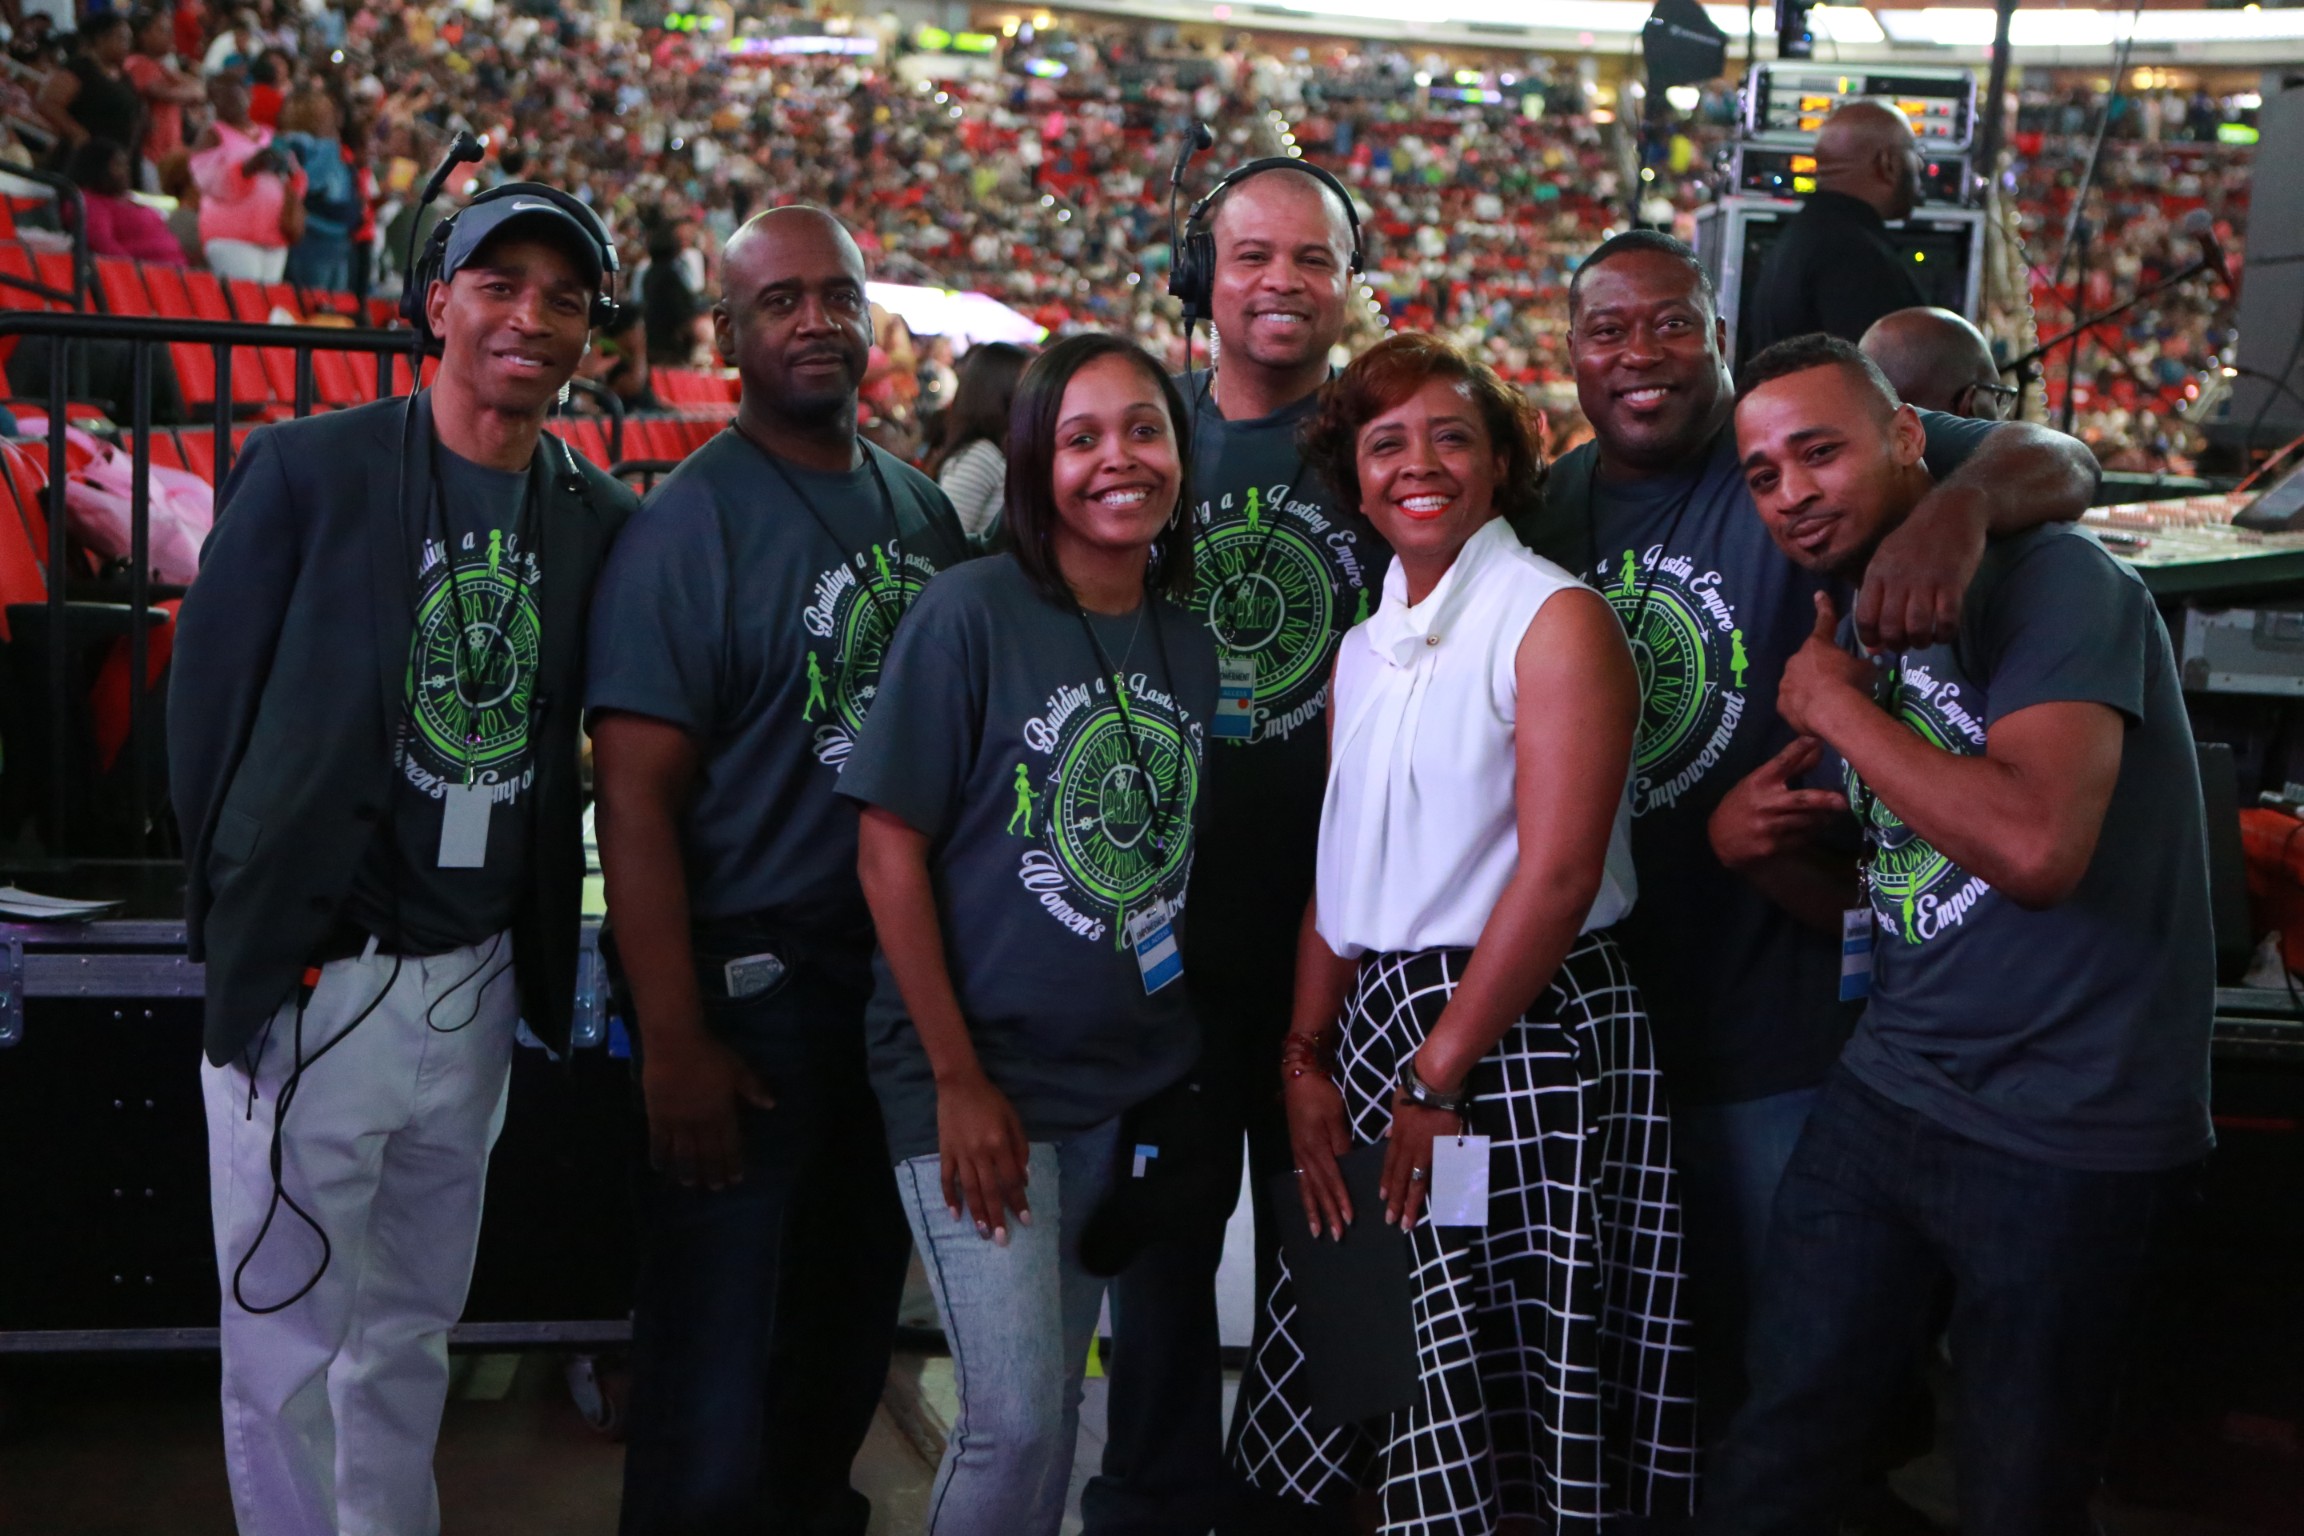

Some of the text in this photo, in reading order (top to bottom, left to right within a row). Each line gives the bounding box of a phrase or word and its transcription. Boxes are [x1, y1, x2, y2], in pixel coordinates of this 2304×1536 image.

[461, 530, 477, 551] a
[1220, 492, 1234, 510] a
[1266, 484, 1331, 533] Lasting
[1326, 529, 1364, 588] Empire
[803, 538, 940, 638] Building a Lastin
[1271, 555, 1312, 608] TODAY
[1689, 571, 1734, 632] Empire
[1278, 615, 1311, 654] AND
[1023, 683, 1093, 755] Building
[1095, 677, 1107, 695] a
[1649, 674, 1682, 716] AND
[1934, 682, 1988, 745] Empire
[403, 751, 450, 801] men's
[1630, 689, 1747, 819] Empowerment
[1018, 849, 1106, 943] Women's
